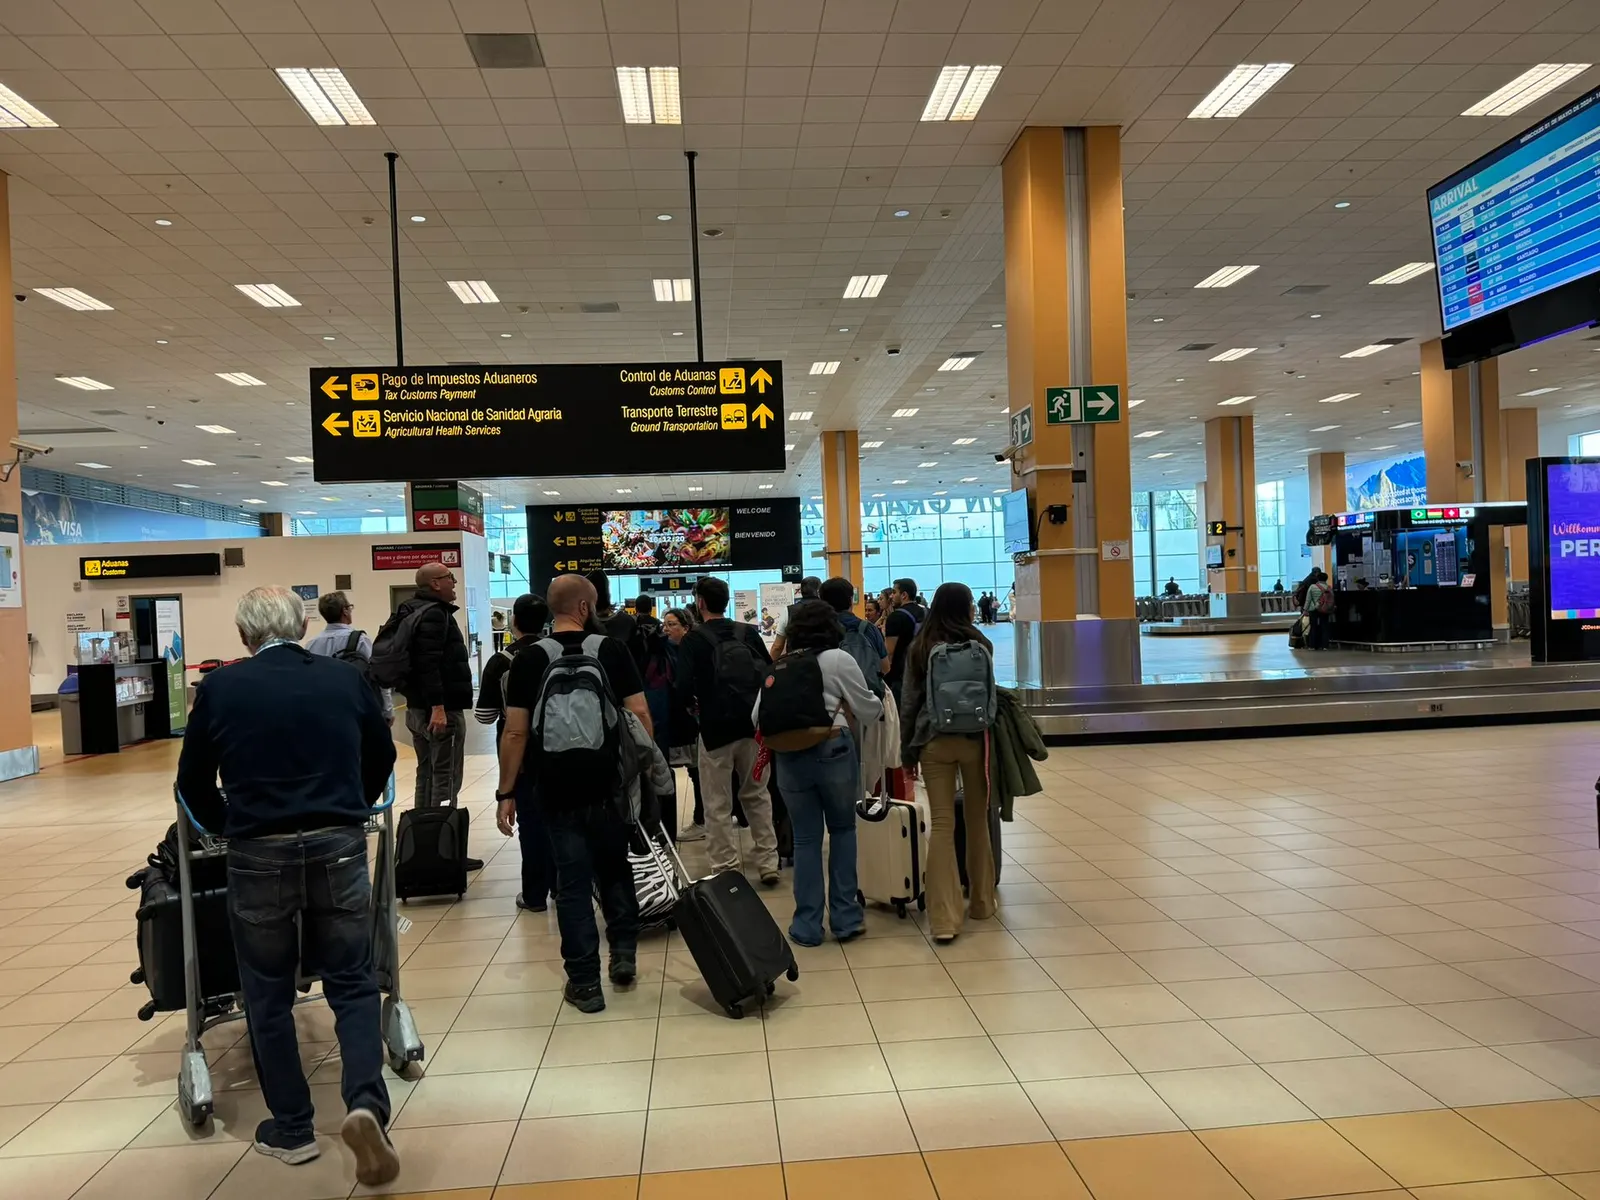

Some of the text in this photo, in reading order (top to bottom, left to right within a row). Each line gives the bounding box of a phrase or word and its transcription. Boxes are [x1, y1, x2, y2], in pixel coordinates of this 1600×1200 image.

[1558, 108, 1572, 121] MAYO
[1432, 176, 1478, 212] ARRIVAL
[1511, 203, 1533, 217] SANTIAGO
[1516, 247, 1538, 260] SANTIAGO
[382, 372, 537, 386] Pago de Impuestos Aduaneros
[620, 370, 716, 382] Control de Aduanas
[385, 389, 476, 401] Tax Customs Payment
[650, 385, 716, 396] Customs Control
[384, 408, 562, 423] Servicio Nacional de Sanidad Agraria
[621, 405, 717, 420] Transporte Terrestre
[385, 426, 500, 438] Agricultural Health Services
[631, 421, 718, 432] Ground Transportation
[59, 521, 82, 538] VISA
[1216, 523, 1223, 533] 2
[1561, 539, 1600, 557] PER
